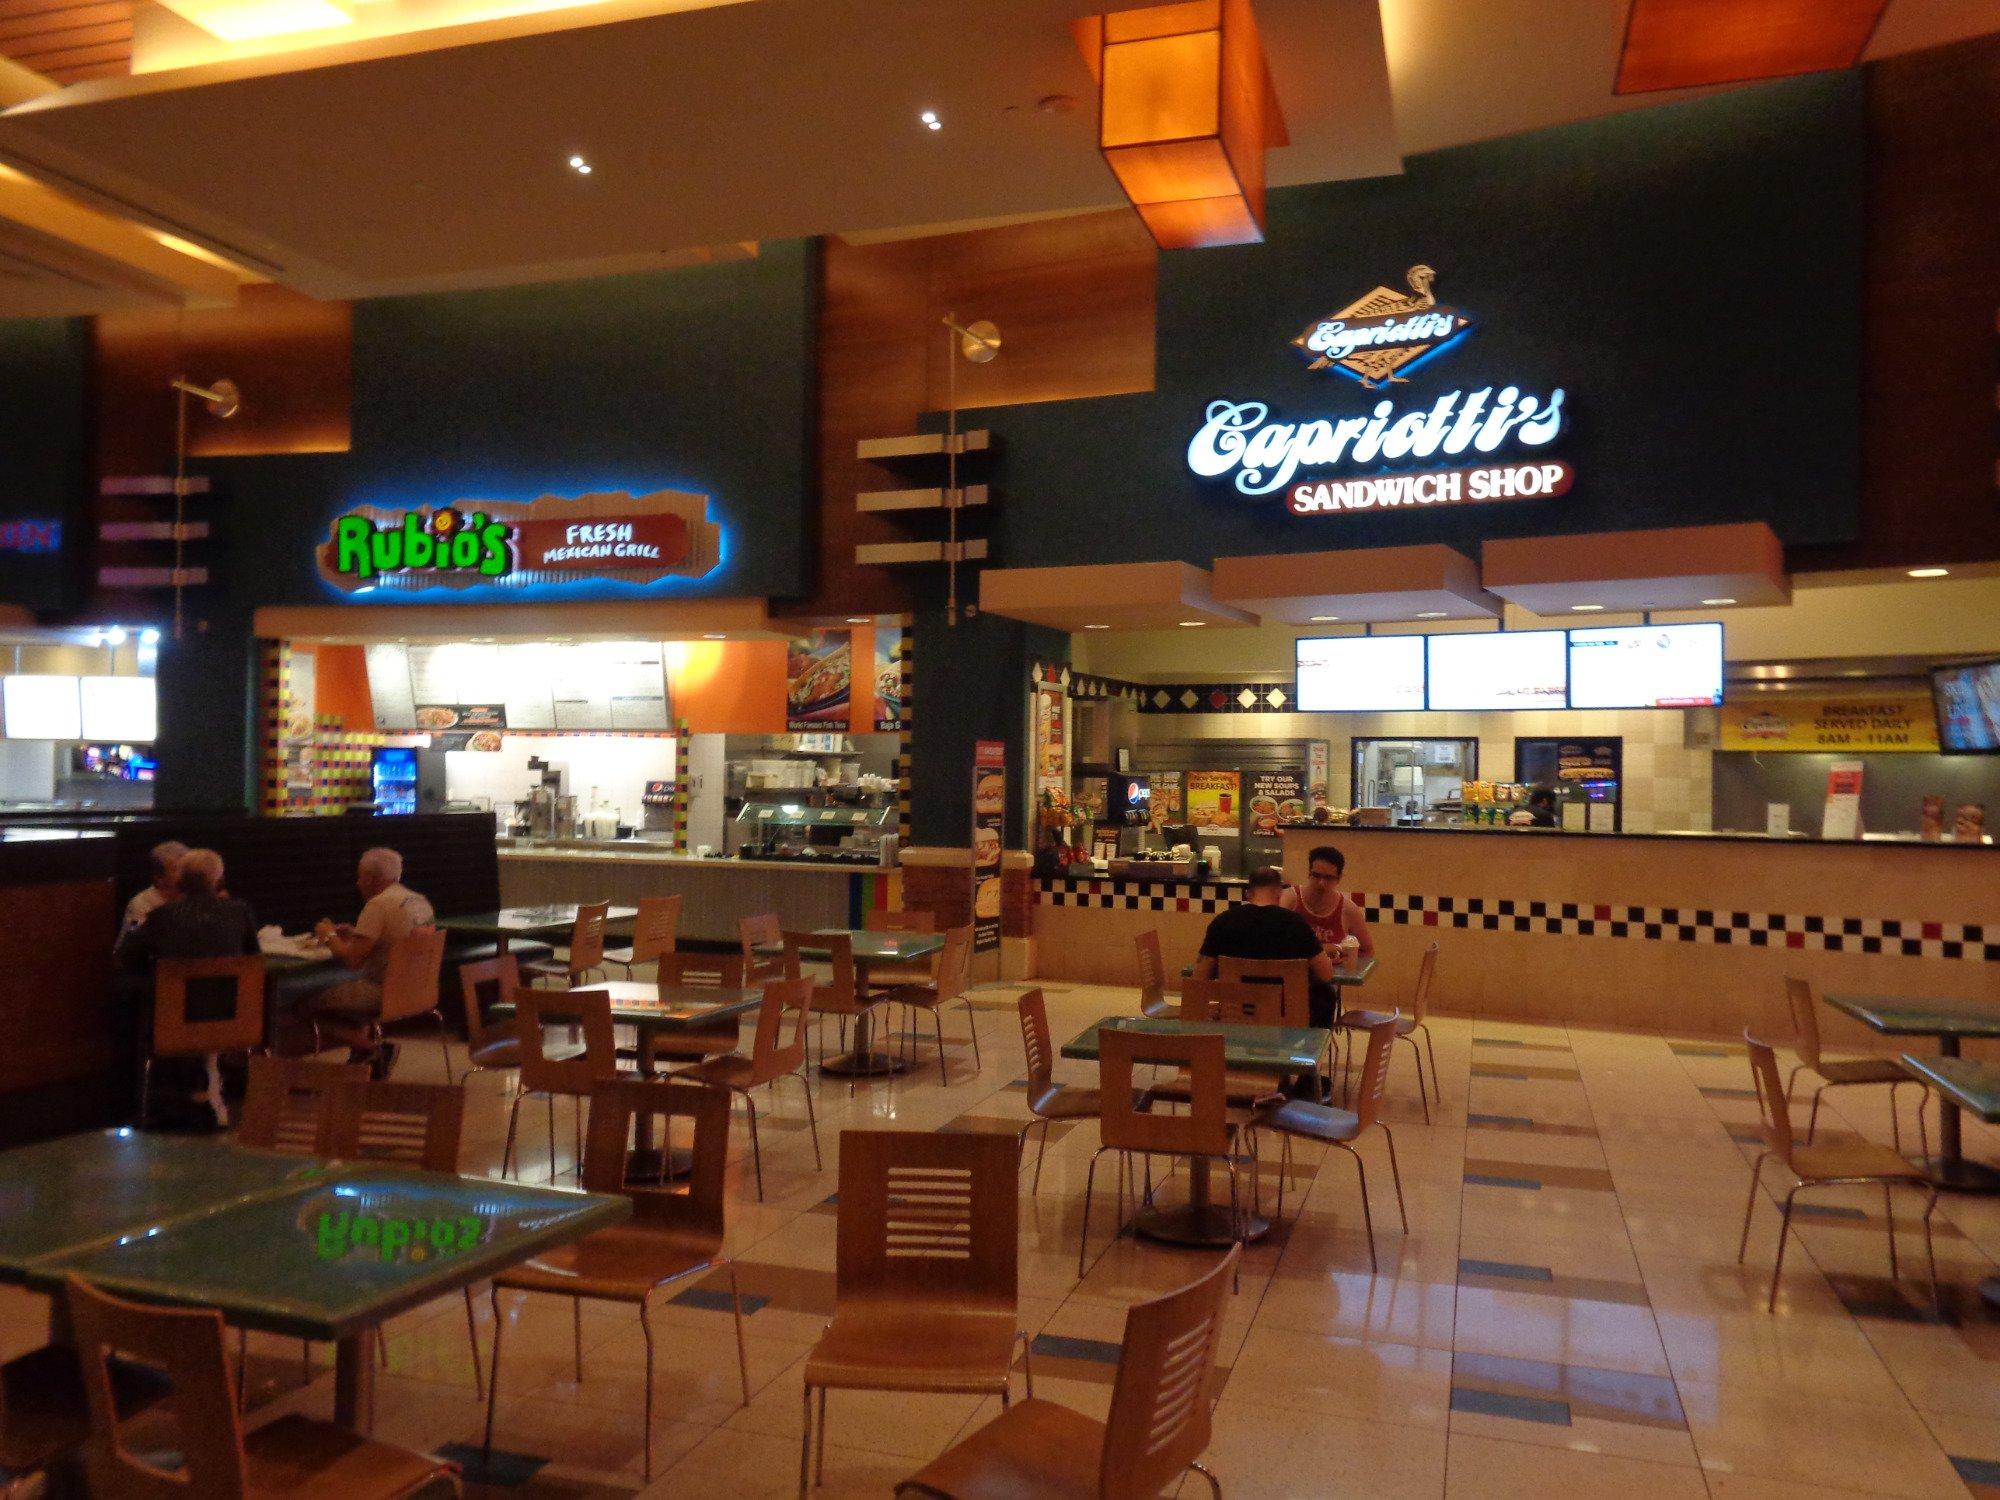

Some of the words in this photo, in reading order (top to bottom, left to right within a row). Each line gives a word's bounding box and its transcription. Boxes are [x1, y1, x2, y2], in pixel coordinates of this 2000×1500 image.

[1187, 386, 1566, 495] Capriotti's
[1293, 472, 1462, 513] SANDWICH
[1468, 464, 1564, 500] SHOP
[566, 523, 633, 545] FRESH
[338, 511, 507, 578] Rubio's
[543, 543, 612, 565] MEXICAN
[614, 542, 661, 560] GRILL
[1822, 704, 1904, 717] BREAKFAST
[1813, 718, 1867, 731] SERVED
[1870, 718, 1913, 731] DAILY
[1867, 733, 1909, 745] 11AM
[1260, 775, 1278, 784] TRY
[1279, 775, 1294, 784] OUR
[1254, 782, 1273, 791] NEW
[1273, 782, 1300, 791] SOUPS
[1265, 789, 1296, 797] SALADS
